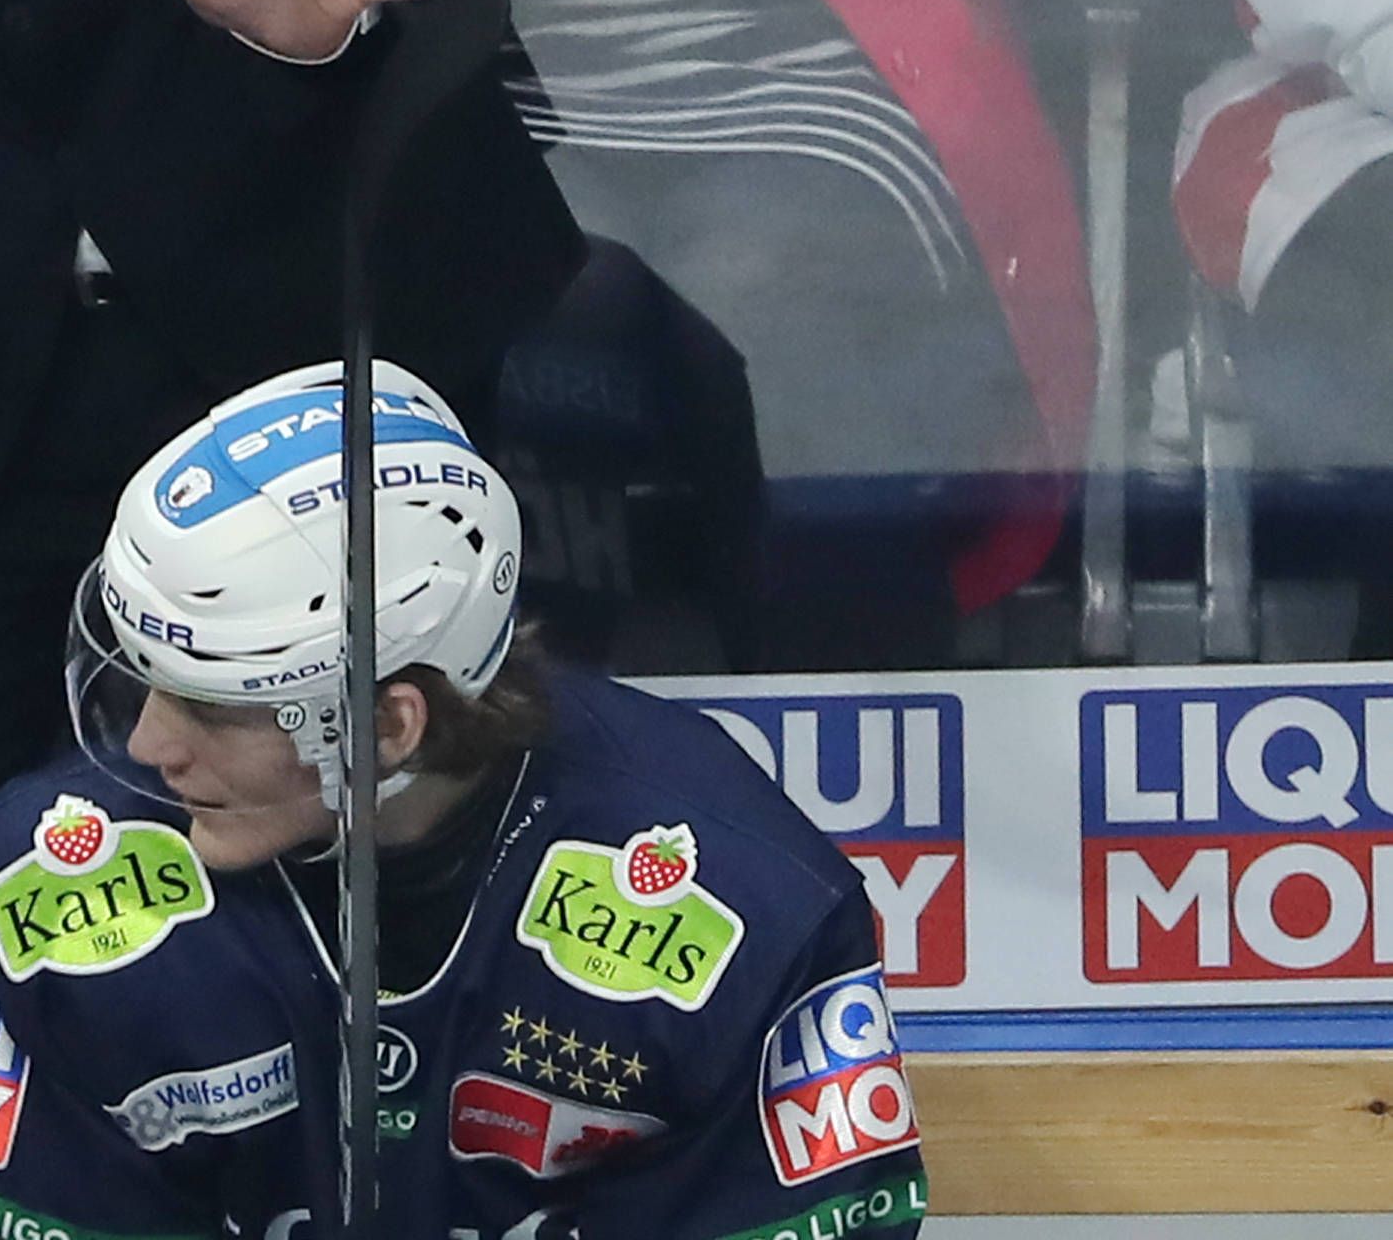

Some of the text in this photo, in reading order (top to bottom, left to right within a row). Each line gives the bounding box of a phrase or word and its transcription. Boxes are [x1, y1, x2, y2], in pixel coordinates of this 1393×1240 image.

[287, 463, 489, 516] STDLER
[1, 852, 191, 957] Karls
[534, 869, 708, 986] Karls
[1105, 841, 1393, 971] MO
[91, 929, 128, 954] 1921
[585, 954, 617, 981] 1921
[155, 1053, 291, 1110] Wolfsdorff
[810, 1189, 894, 1240] LIGO
